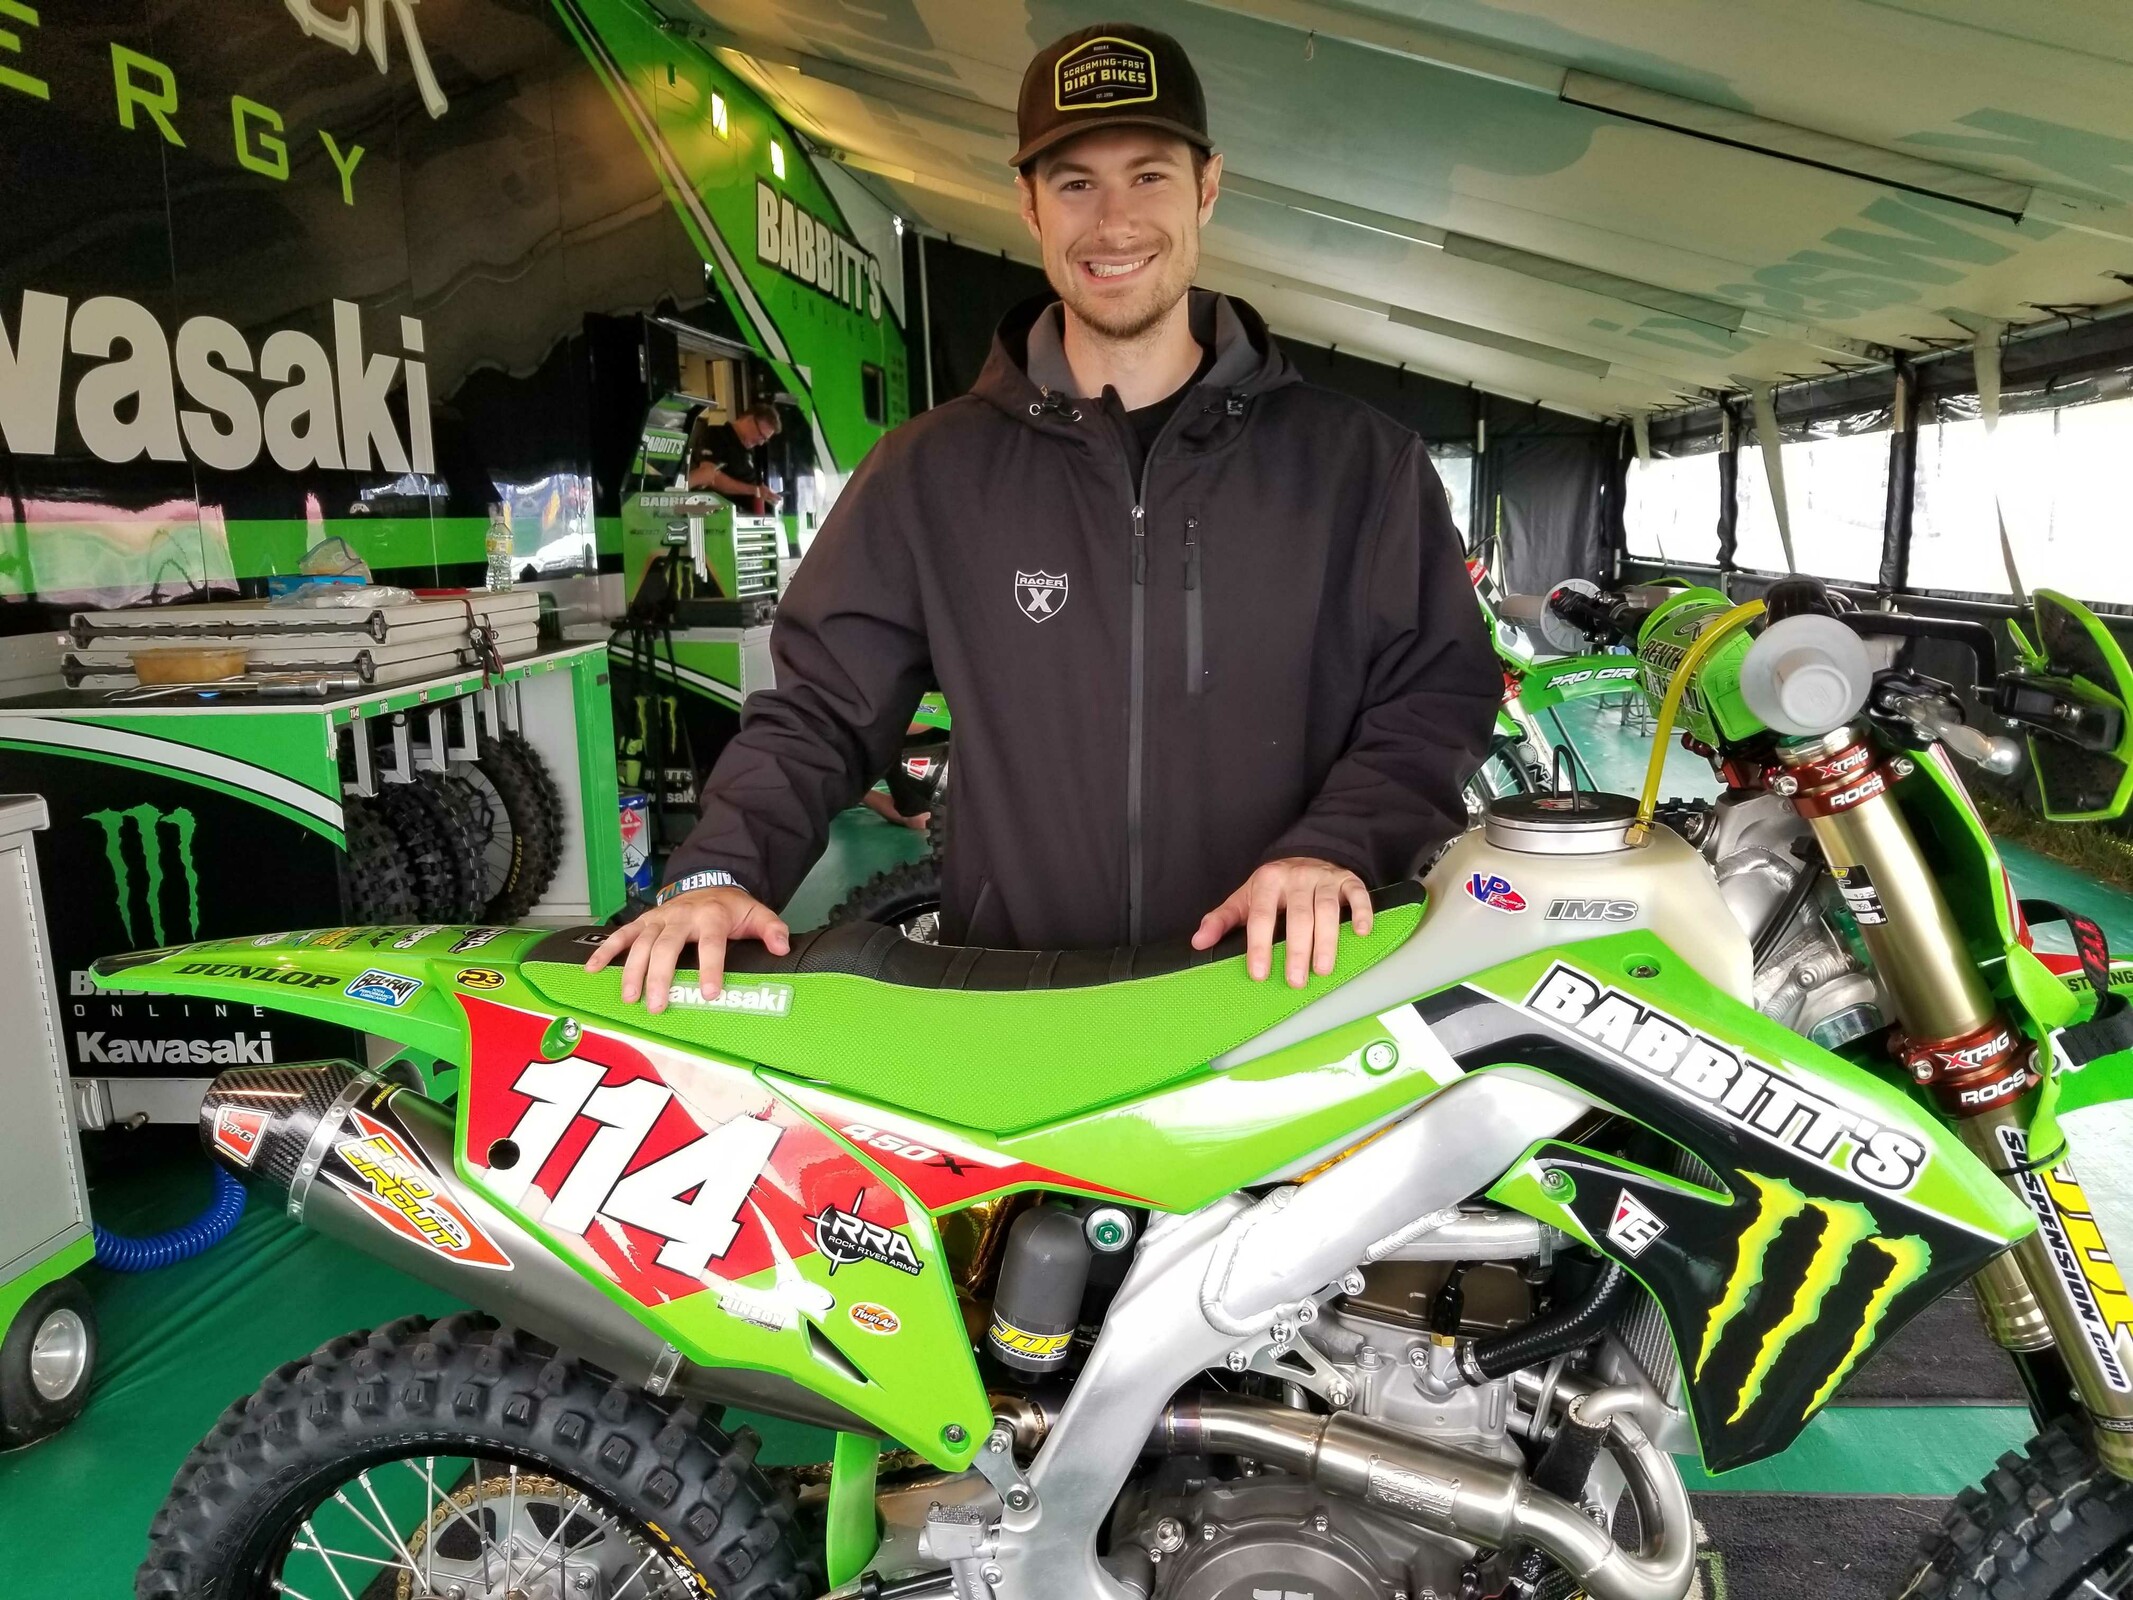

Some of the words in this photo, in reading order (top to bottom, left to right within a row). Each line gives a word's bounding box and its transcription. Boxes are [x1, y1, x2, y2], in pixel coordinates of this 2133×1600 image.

[1063, 58, 1145, 79] SCREAMING-FAST
[1064, 72, 1096, 92] DIRT
[1101, 69, 1146, 84] BIKES
[757, 181, 881, 320] BABBITT'S
[1020, 577, 1063, 587] RACER
[1026, 588, 1053, 613] X
[1544, 669, 1594, 690] PRO
[1815, 747, 1869, 779] XTRIG
[1830, 774, 1886, 806] ROCS
[1473, 873, 1511, 904] VP
[1544, 898, 1639, 922] IMS
[173, 963, 342, 989] DUNLOP
[74, 1004, 265, 1018] ONLINE
[668, 985, 788, 1012] awasaki
[76, 1031, 274, 1064] Kawasaki
[1935, 1031, 2011, 1070] XTRIG
[1527, 963, 1929, 1190] BABBITT'S
[1960, 1067, 2028, 1105] ROCS
[362, 1136, 434, 1201] PRO
[482, 1056, 787, 1281] 114
[339, 1143, 463, 1250] CIRCUIT
[831, 1211, 920, 1267] RRA
[827, 1235, 855, 1250] ROCK
[857, 1245, 888, 1263] RIVER
[890, 1257, 919, 1275] ARMS
[855, 1306, 879, 1325] Twin
[877, 1315, 898, 1331] Air
[1267, 1343, 1290, 1359] WCL
